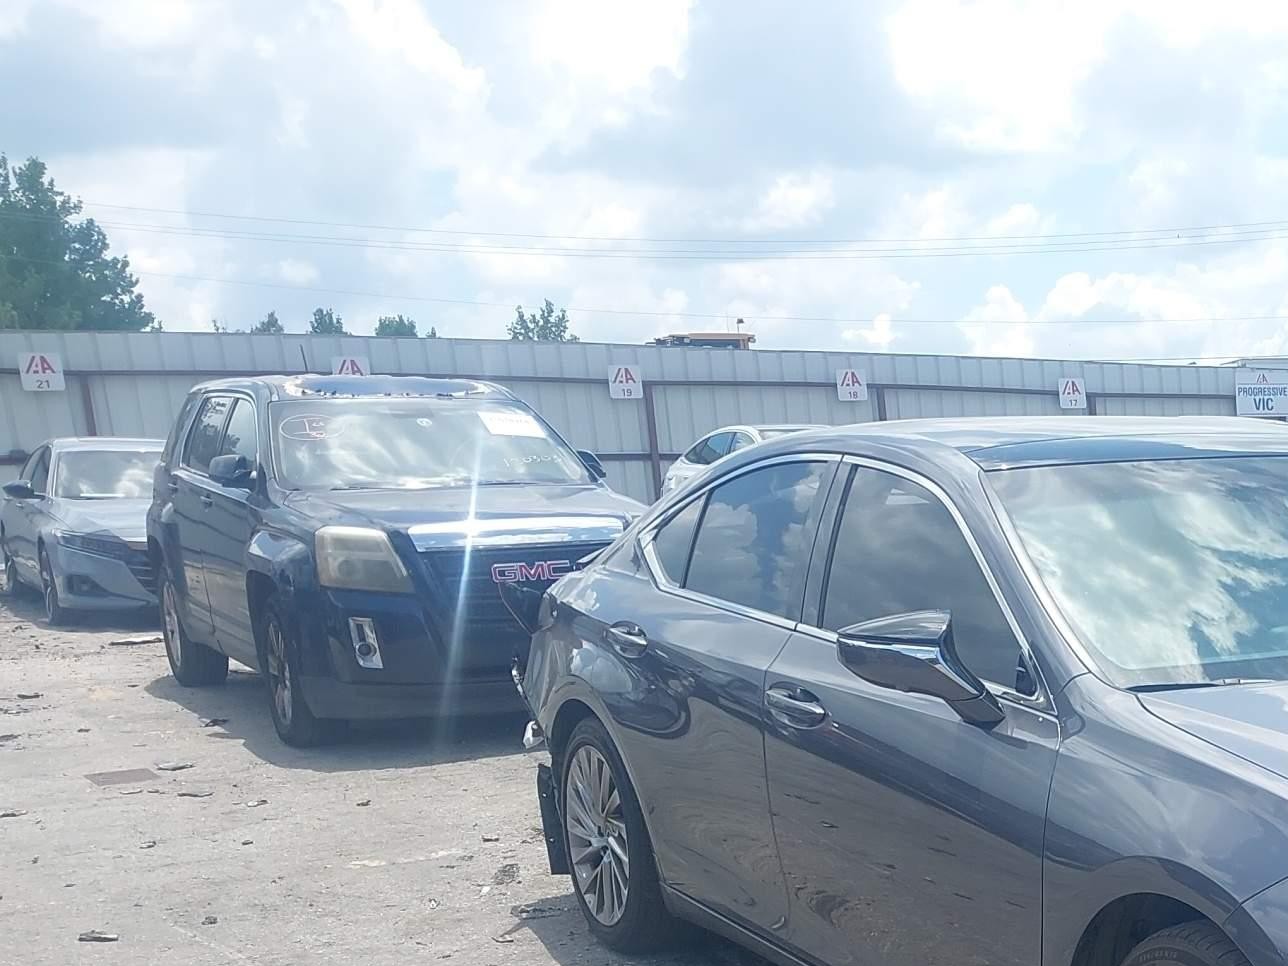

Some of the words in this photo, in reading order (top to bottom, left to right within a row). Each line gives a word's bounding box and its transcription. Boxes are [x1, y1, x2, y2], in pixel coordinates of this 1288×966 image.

[36, 379, 50, 389] 21
[1237, 386, 1288, 397] PROGRESSIVE
[1069, 399, 1078, 407] 17
[1253, 397, 1275, 411] VIC
[491, 559, 570, 583] GMC
